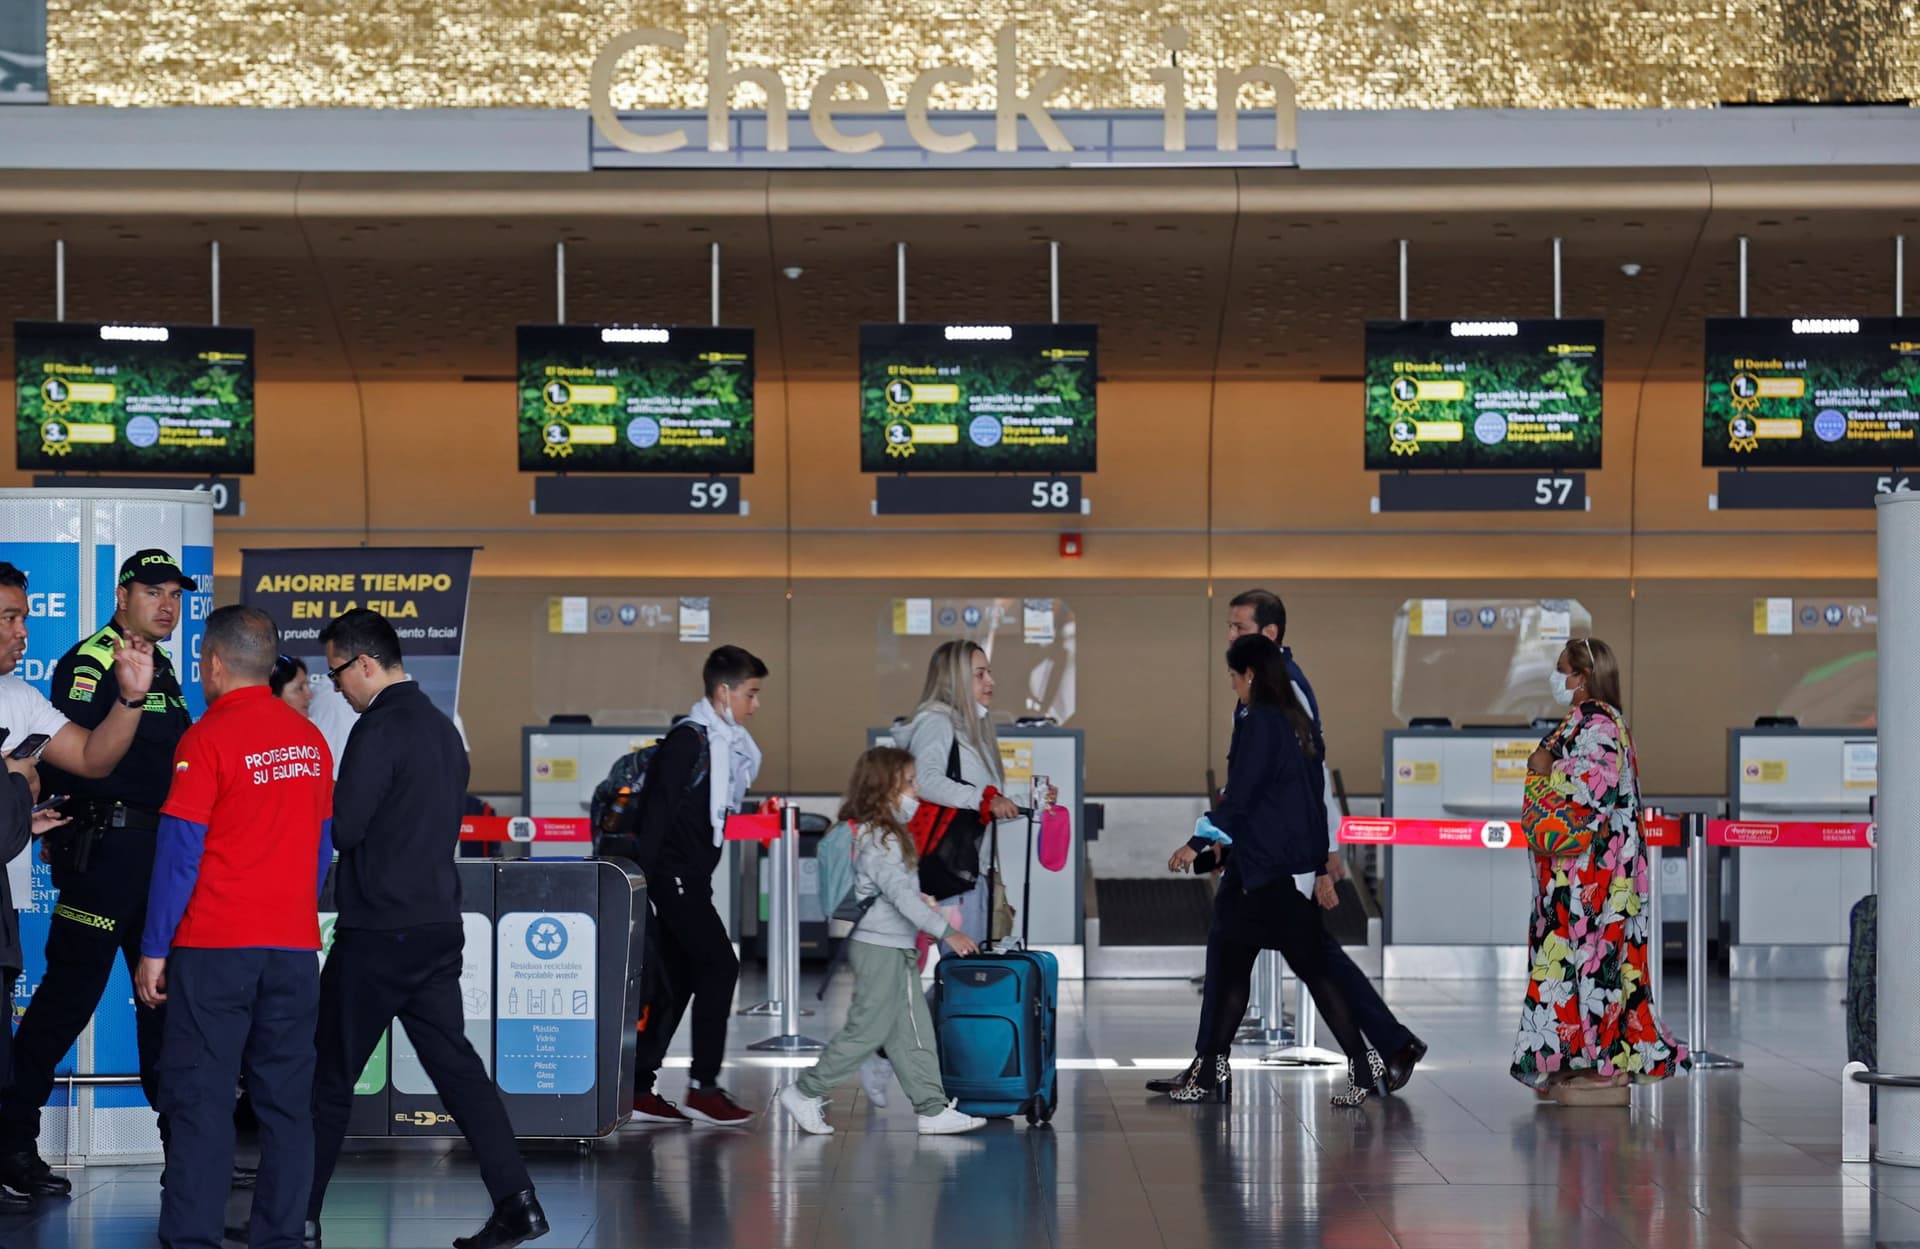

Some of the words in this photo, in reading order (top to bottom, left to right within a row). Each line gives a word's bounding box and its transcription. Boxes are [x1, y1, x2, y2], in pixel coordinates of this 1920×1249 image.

[589, 24, 1075, 153] Check
[1149, 25, 1298, 152] in
[1792, 319, 1859, 333] SAMSUNG
[1734, 359, 1743, 369] El
[1745, 359, 1783, 369] Dorado
[1797, 359, 1807, 369] el
[1848, 410, 1875, 420] Cinco
[1877, 410, 1919, 420] estrellas
[1888, 421, 1901, 429] en
[192, 483, 228, 509] 0
[690, 482, 728, 508] 59
[1031, 481, 1069, 507] 58
[1535, 478, 1574, 505] 57
[141, 555, 178, 567] POLI
[256, 574, 355, 593] AHORRE
[361, 574, 452, 592] TIEMPO
[291, 601, 324, 619] EN
[428, 627, 457, 638] facial
[245, 745, 320, 769] PROTEGEMOS
[254, 769, 268, 784] SU
[273, 763, 320, 780] EQUIPAJE
[510, 962, 542, 970] Residuos
[544, 962, 582, 970] reciclables
[514, 971, 554, 981] Recyclable
[532, 1024, 560, 1033] Plástico
[536, 1034, 556, 1042] Vidrio
[536, 1044, 555, 1052] Latas
[534, 1061, 557, 1070] Plastic
[536, 1071, 555, 1079] Glass
[395, 1113, 414, 1122] EL
